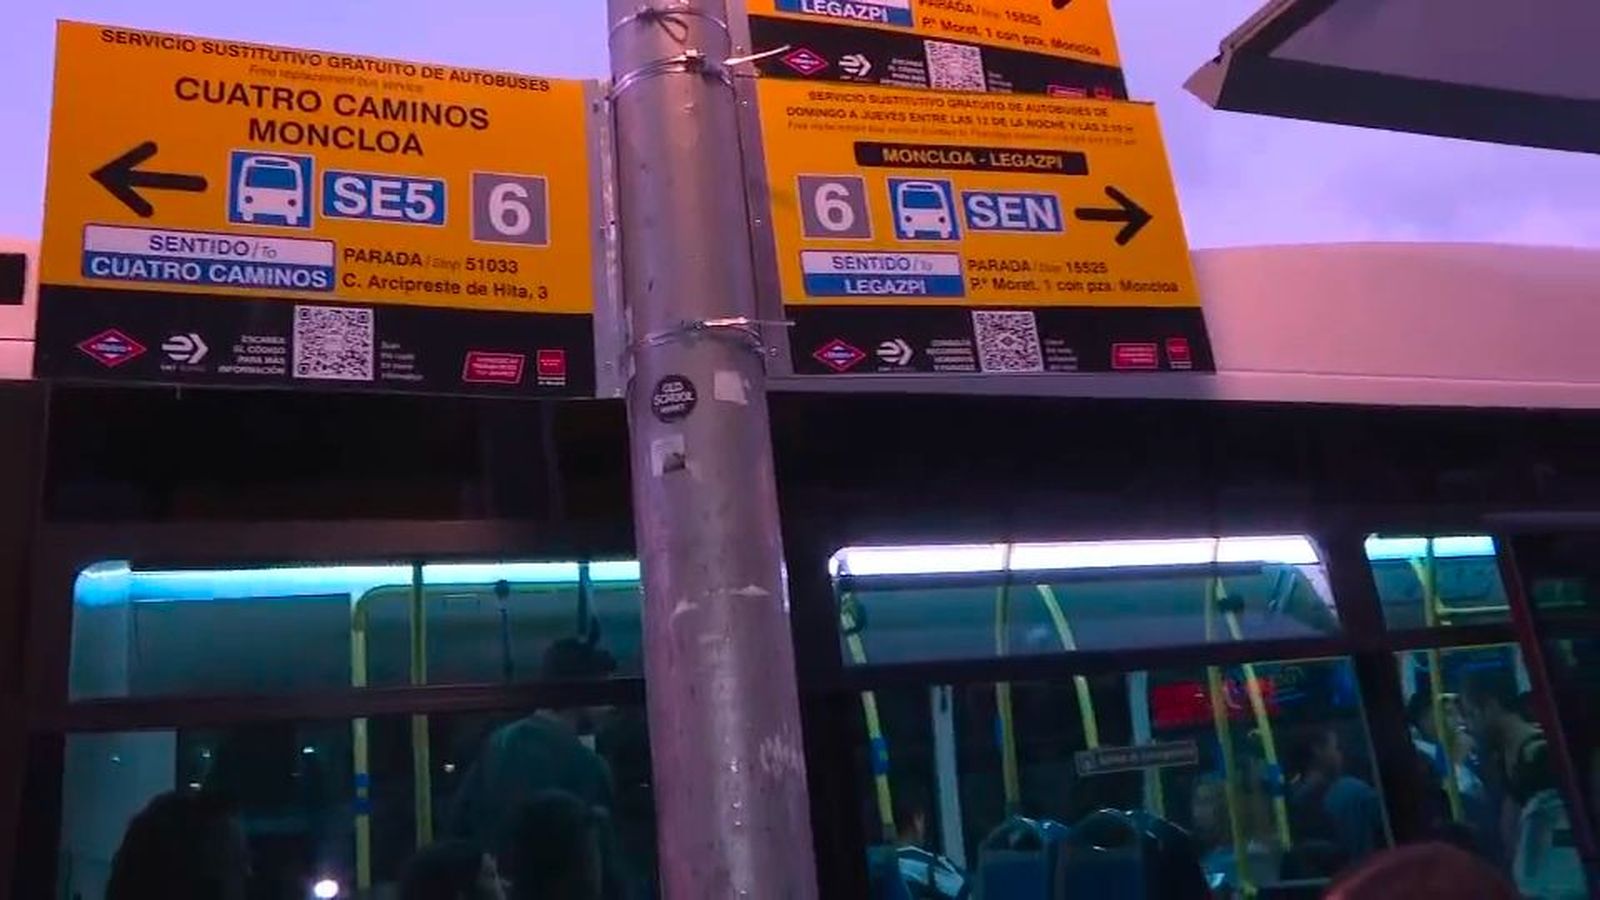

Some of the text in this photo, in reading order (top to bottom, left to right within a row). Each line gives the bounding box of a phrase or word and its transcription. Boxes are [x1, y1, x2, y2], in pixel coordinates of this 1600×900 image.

[802, 0, 888, 22] LEGAZPI
[101, 29, 550, 92] SERVICIO SUSTITUTIVO GRATUITO DE AUTOBUSES
[175, 77, 490, 130] CUATRO CAMINOS
[786, 106, 847, 119] DOMINGO
[850, 110, 859, 120] A
[909, 112, 948, 124] ENTRE
[951, 115, 973, 125] LAS
[992, 117, 1006, 127] DE
[248, 117, 424, 156] MONCLOA
[882, 147, 977, 165] MONCLOA
[989, 152, 1064, 169] LEGAZPI
[333, 177, 436, 221] SE5
[489, 182, 532, 236] 6
[815, 182, 855, 231] 6
[967, 195, 1057, 229] SEN
[91, 255, 327, 289] CUATRO CAMINOS
[343, 248, 423, 267] PARADA
[465, 257, 519, 274] 51033
[967, 260, 1031, 273] PARADA
[342, 273, 361, 288] C.
[368, 274, 461, 295] Arcipreste
[466, 283, 488, 296] de
[538, 286, 548, 299] 3
[844, 279, 926, 294] LEGAZPI
